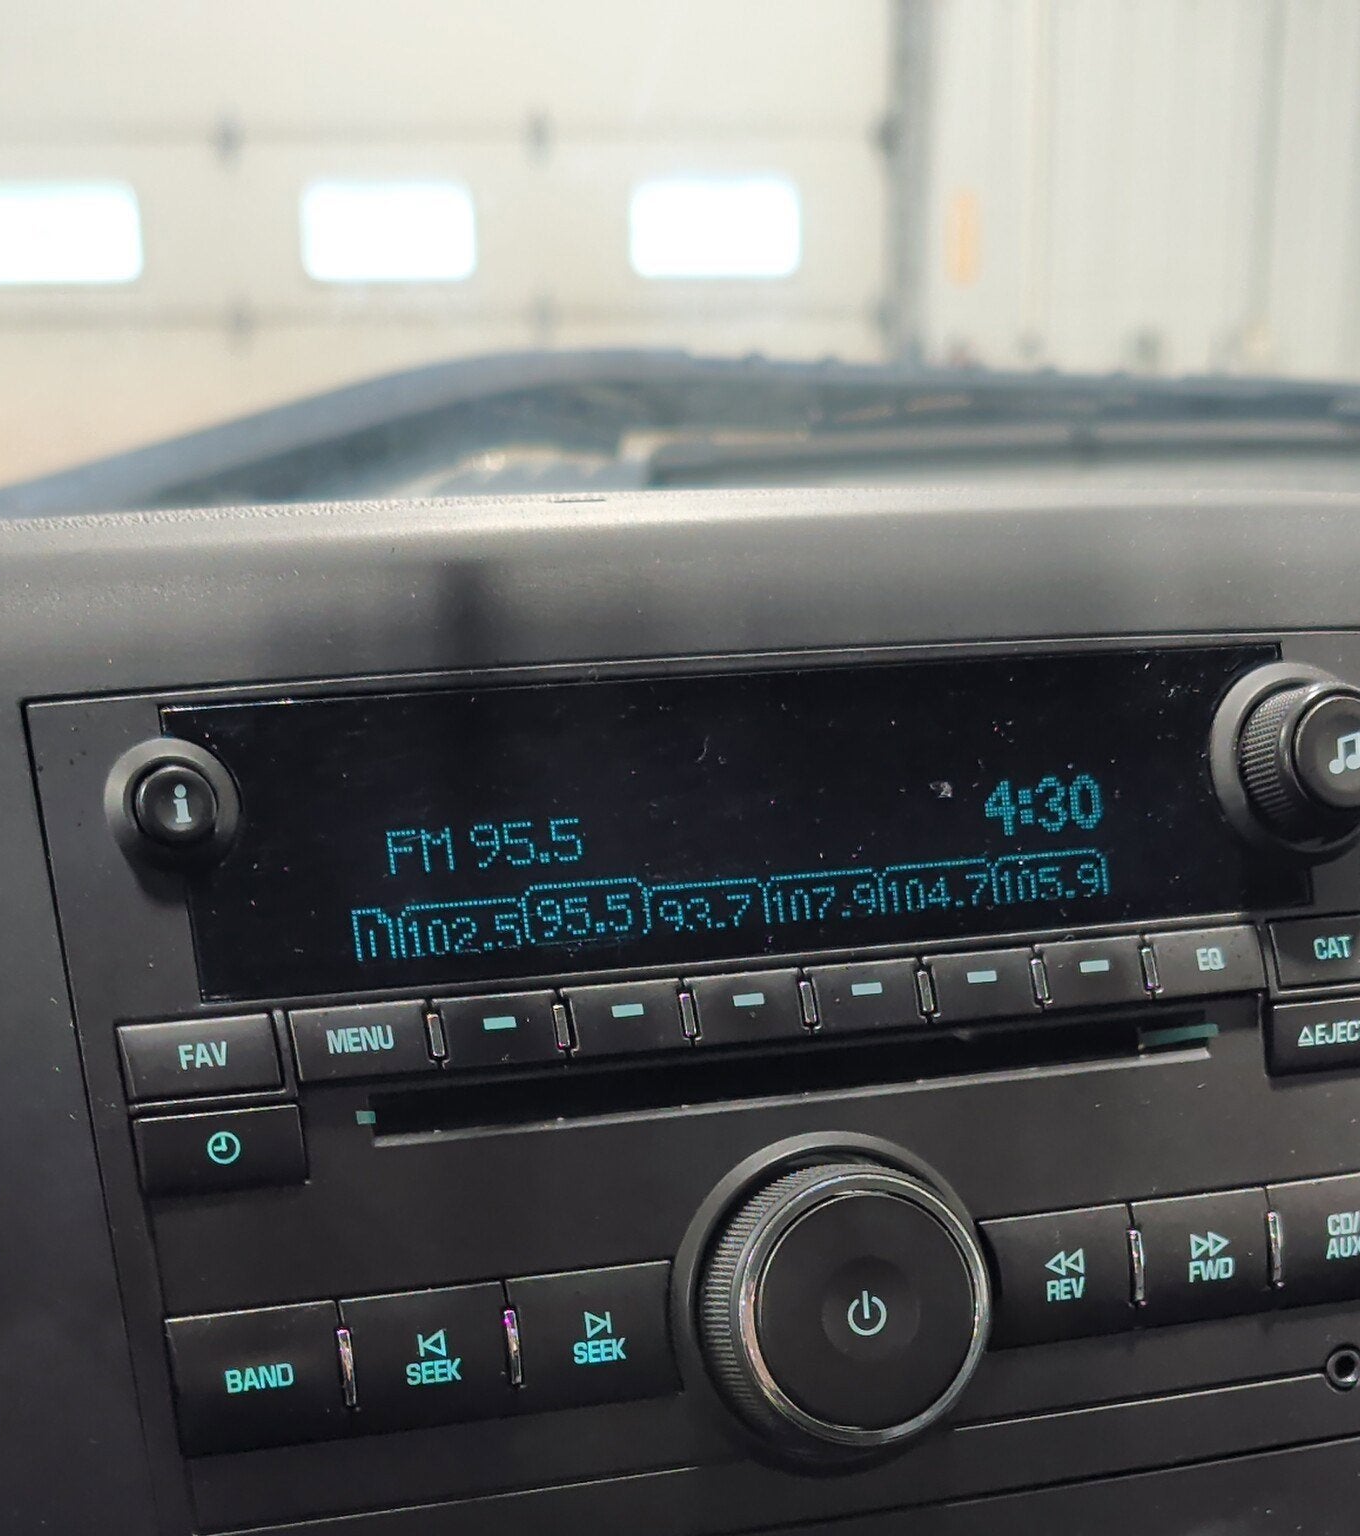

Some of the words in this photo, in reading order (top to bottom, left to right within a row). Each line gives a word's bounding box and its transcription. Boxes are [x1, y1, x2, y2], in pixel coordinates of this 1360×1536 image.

[984, 774, 1103, 836] 4:30
[386, 826, 454, 874] FM
[469, 817, 582, 869] 95.5
[537, 893, 633, 938] 95.5
[1195, 946, 1226, 972] EQ
[1313, 935, 1351, 961] CAT
[326, 1024, 395, 1056] MENU
[178, 1041, 228, 1071] FAV
[1188, 1256, 1235, 1283] FWD
[1045, 1276, 1085, 1303] REV
[572, 1336, 626, 1365] SEEK
[224, 1362, 295, 1394] BAND
[405, 1357, 462, 1386] SEEK
